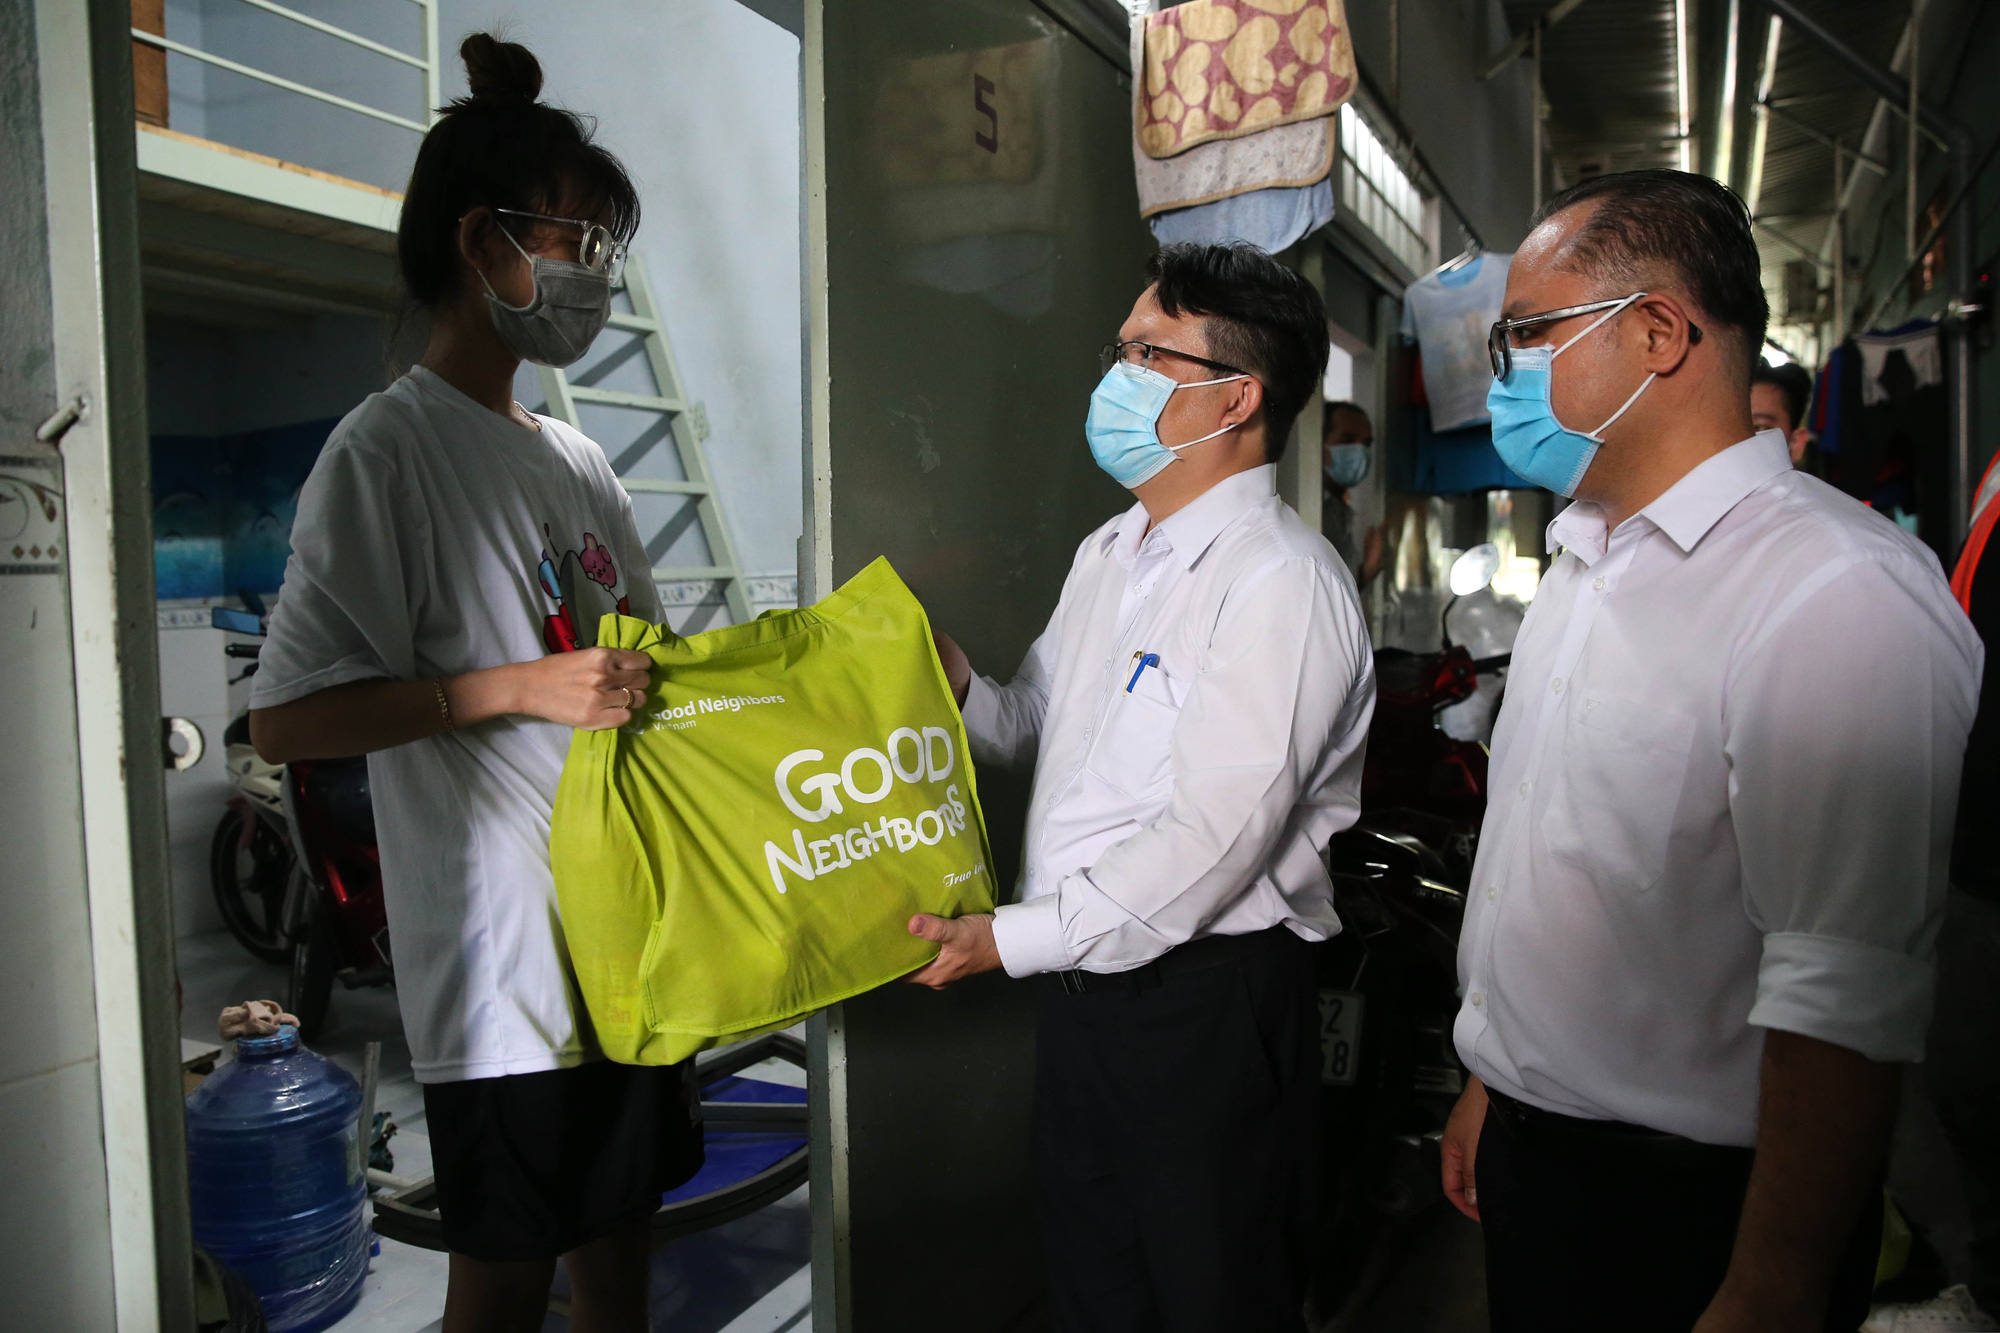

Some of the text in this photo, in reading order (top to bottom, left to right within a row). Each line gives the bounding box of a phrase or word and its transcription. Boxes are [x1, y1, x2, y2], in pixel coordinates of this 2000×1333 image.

[974, 72, 998, 154] 5
[697, 694, 786, 714] Neighbors
[774, 726, 954, 823] GOOD
[764, 784, 966, 894] NEIGHBORS
